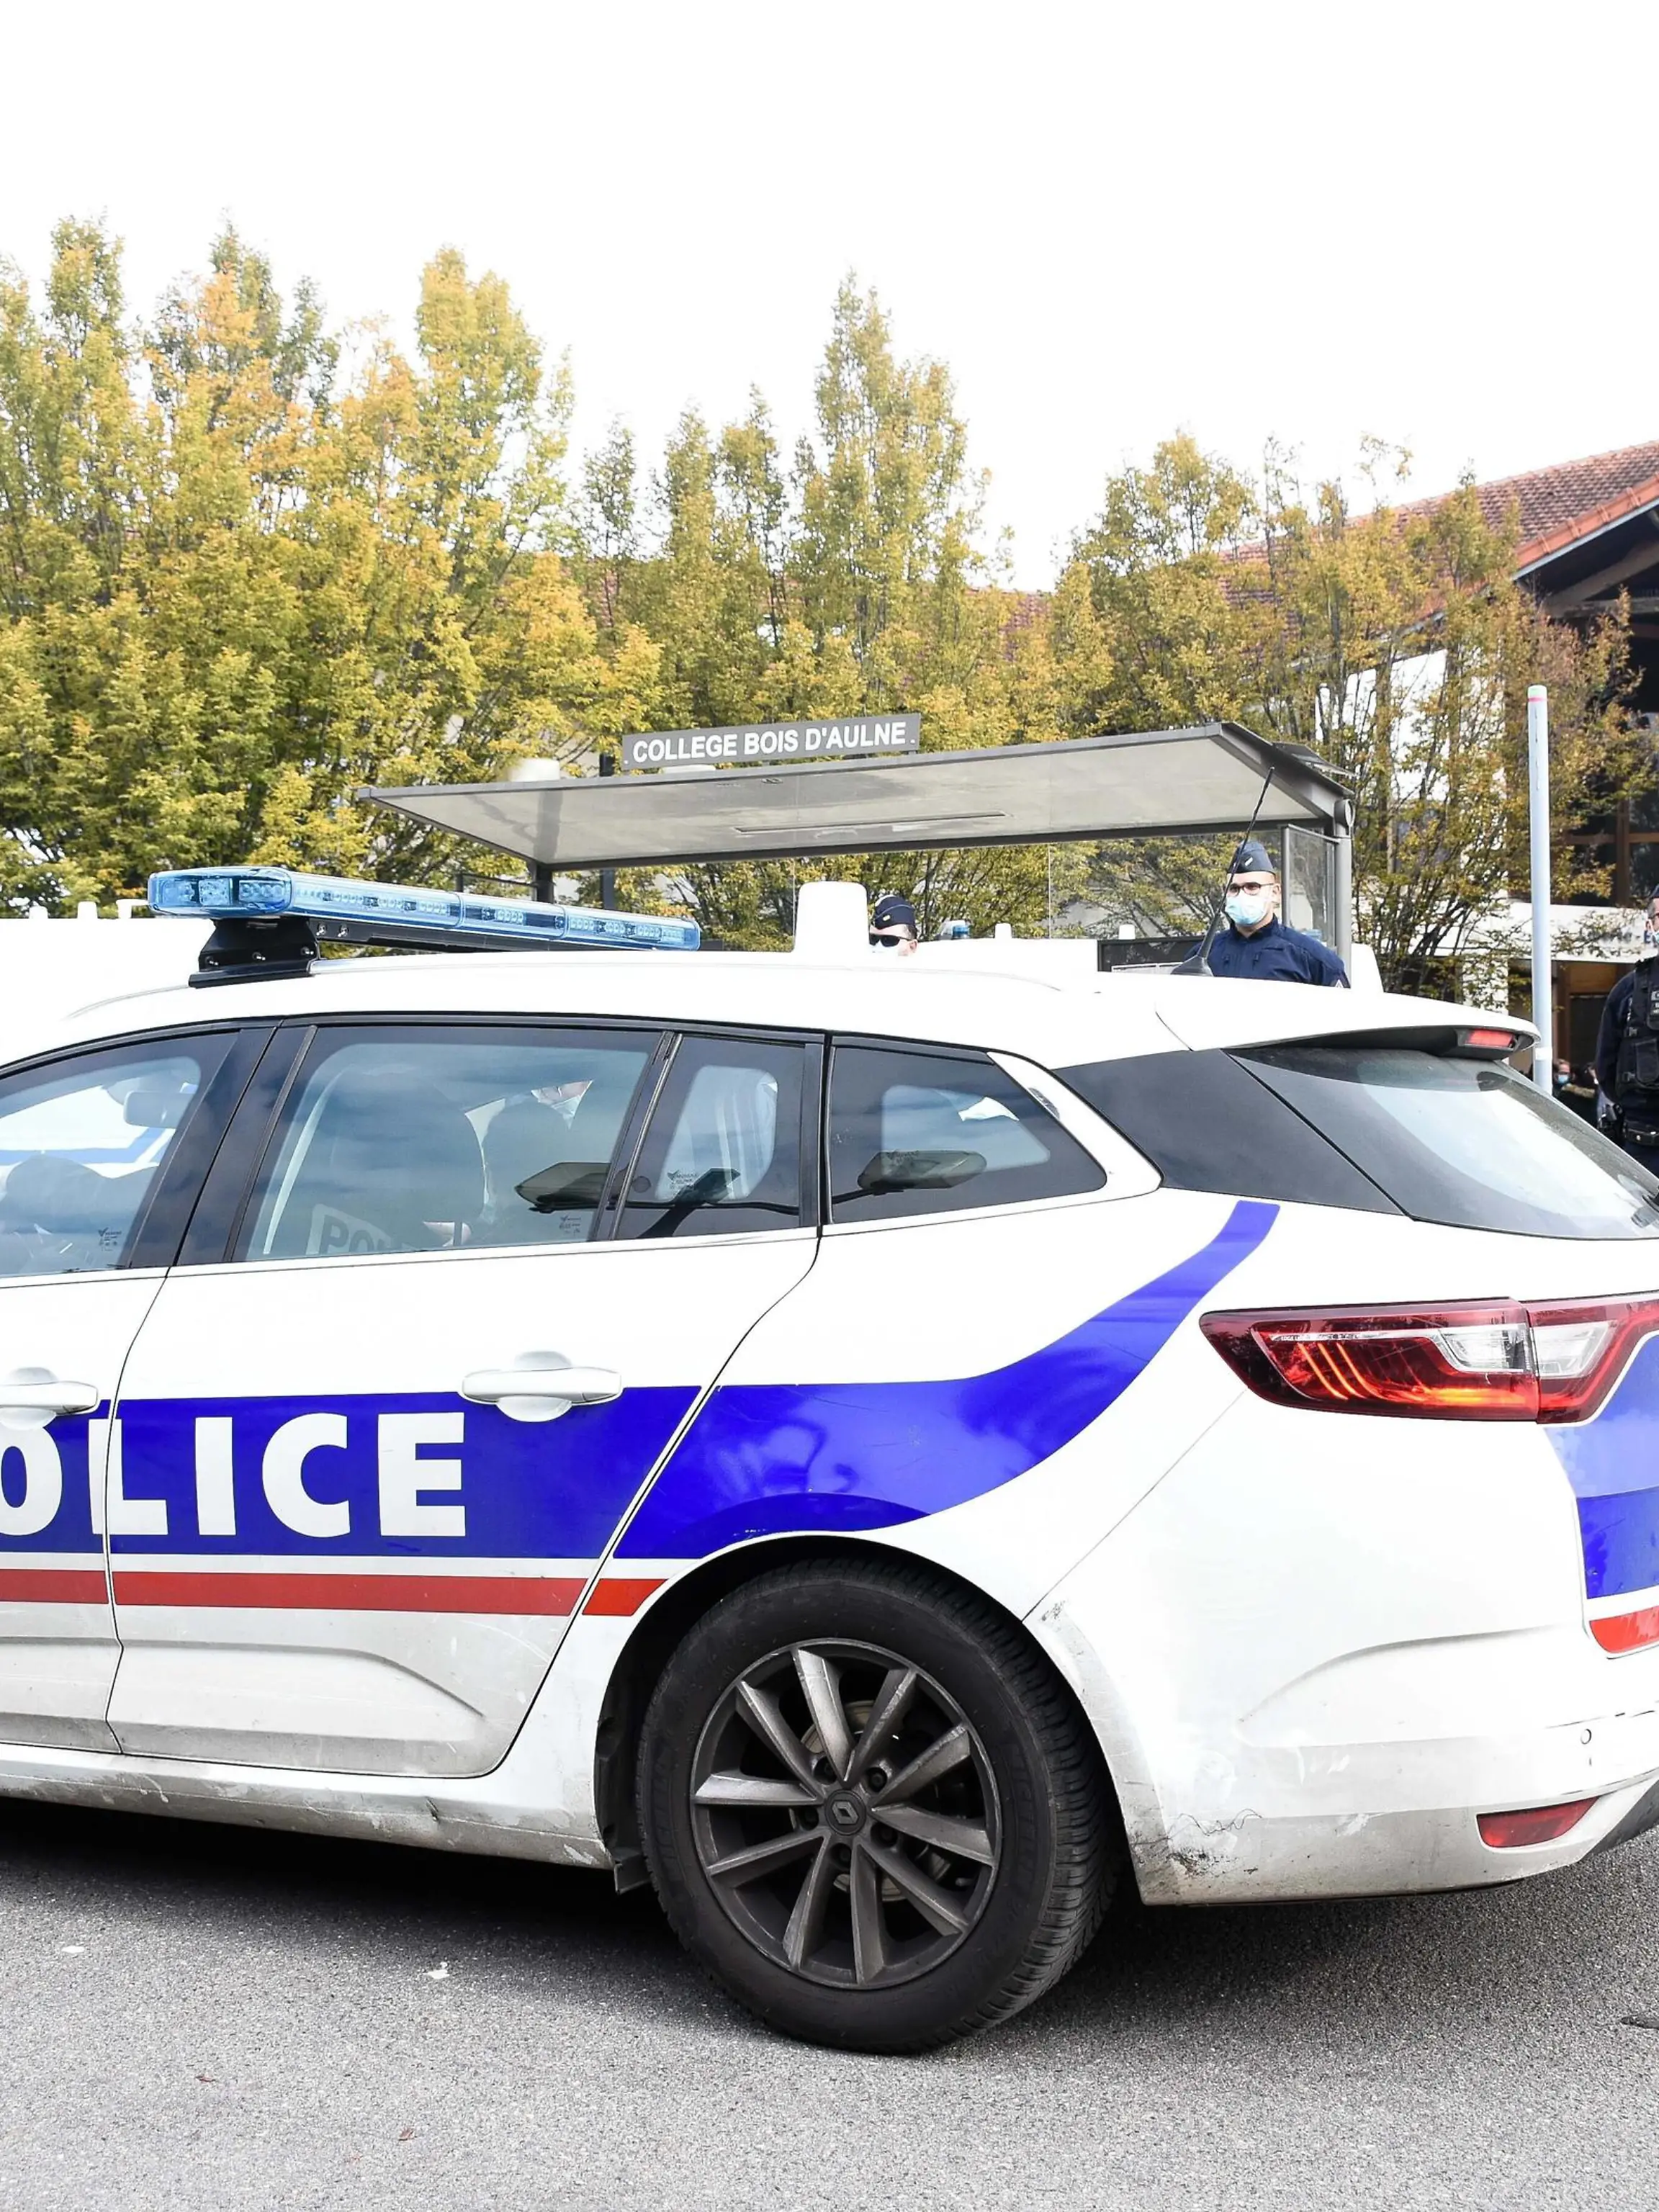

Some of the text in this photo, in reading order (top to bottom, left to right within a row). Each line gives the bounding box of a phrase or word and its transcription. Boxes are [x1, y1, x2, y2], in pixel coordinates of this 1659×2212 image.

[632, 721, 907, 763] COLLEGE BOIS D'AULNE
